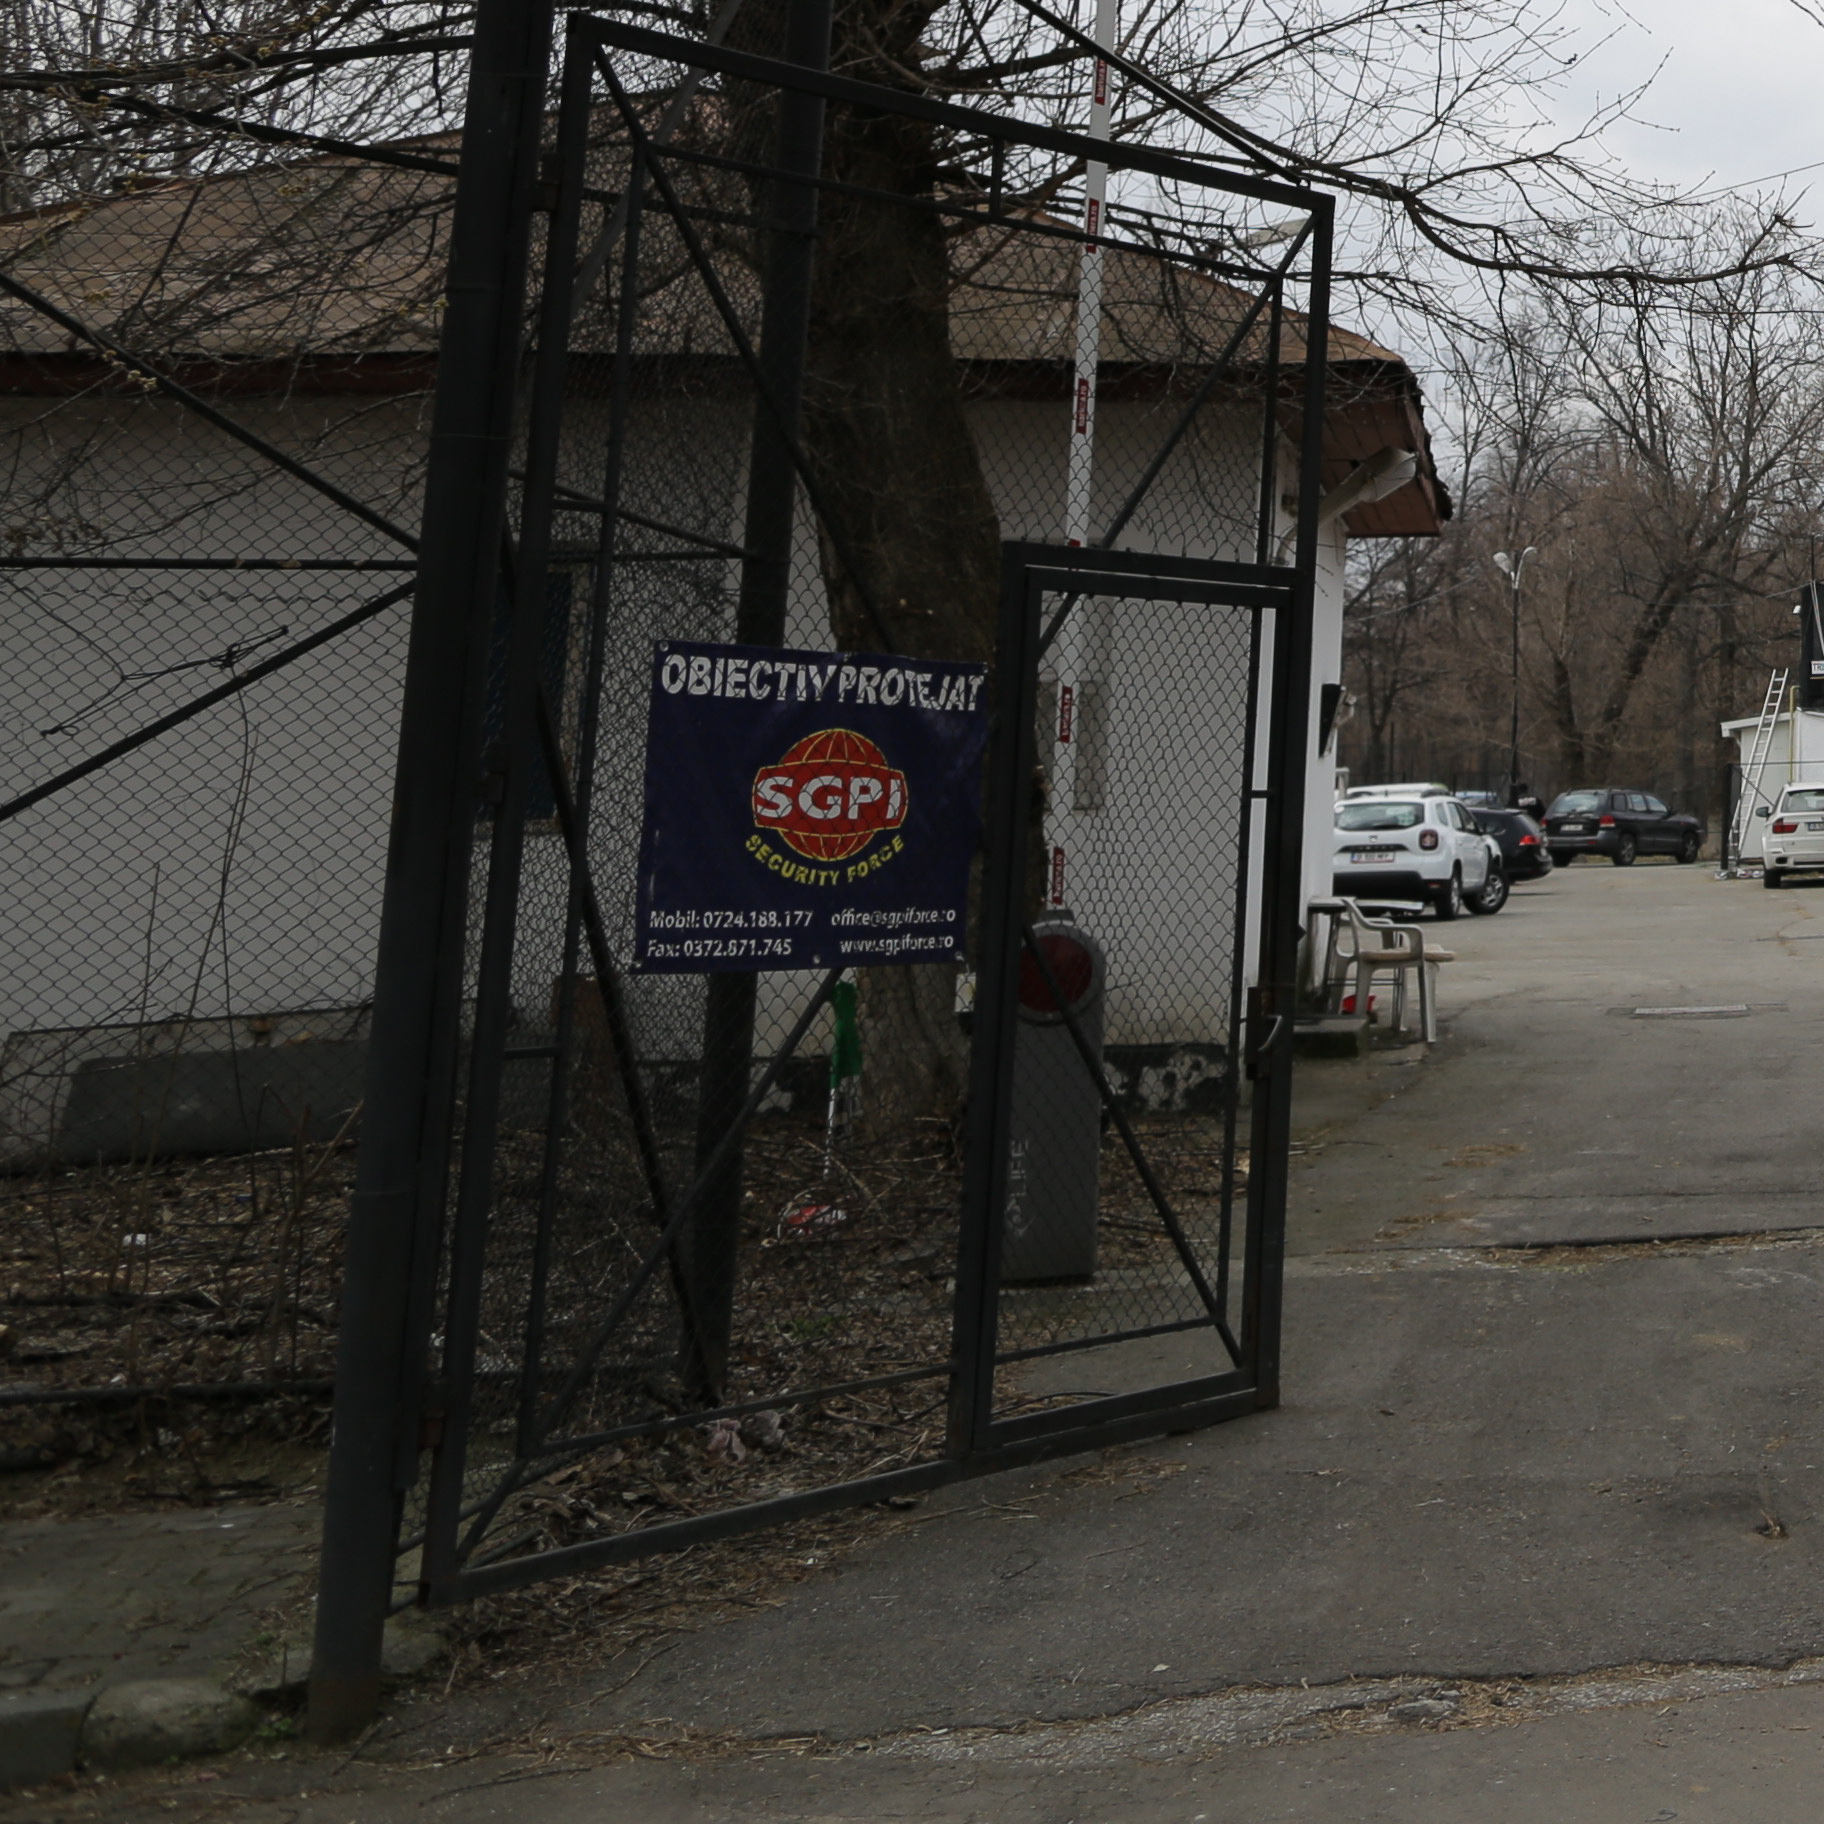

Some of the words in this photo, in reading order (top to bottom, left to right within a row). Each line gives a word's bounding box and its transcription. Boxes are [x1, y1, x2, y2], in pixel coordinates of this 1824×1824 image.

[1097, 60, 1106, 98] bariera.r
[661, 653, 837, 702] OBIECTIV
[838, 665, 985, 711] PROTEJAT
[756, 775, 901, 820] SGPI
[745, 834, 840, 886] SECURITY
[847, 834, 905, 883] FORCE
[649, 910, 701, 929] Mobil:
[703, 909, 814, 928] 0724.188.177
[831, 906, 957, 929] office@sgpiforce.ro
[647, 939, 681, 958] Fax:
[683, 938, 792, 957] 0372.871.745
[839, 933, 954, 956] www.sgpiforce.ro
